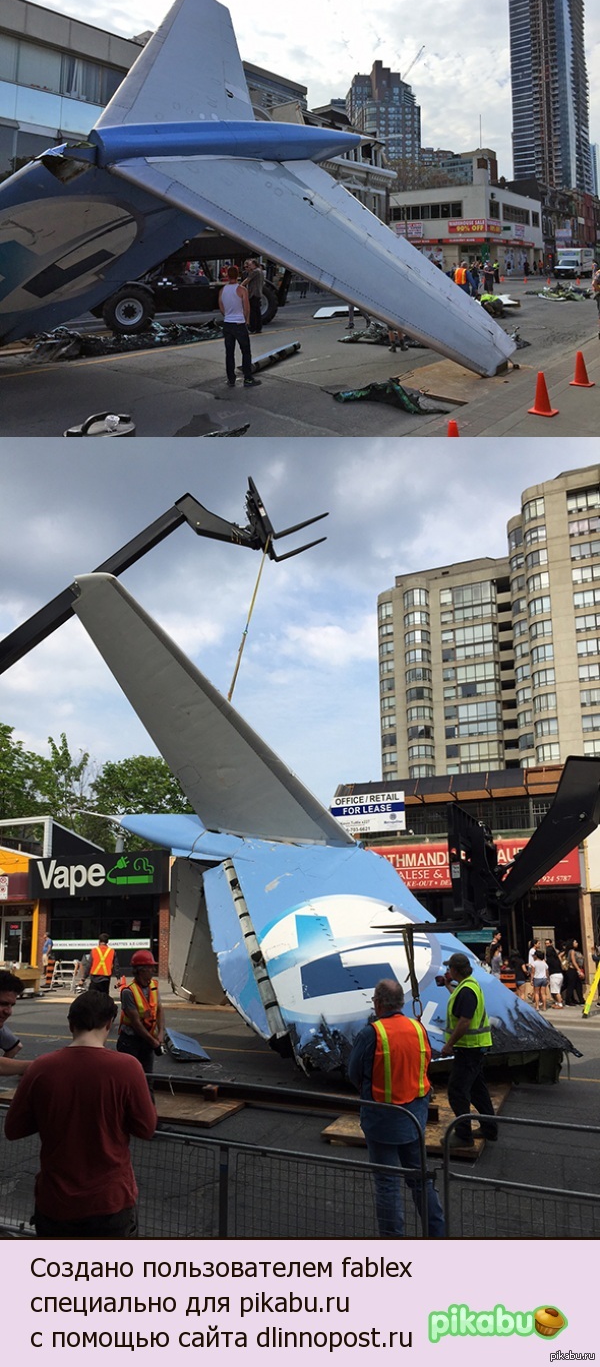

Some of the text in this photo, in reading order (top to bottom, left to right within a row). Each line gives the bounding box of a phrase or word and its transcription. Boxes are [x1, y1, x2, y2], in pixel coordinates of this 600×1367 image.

[335, 795, 364, 805] OFFICE
[369, 793, 399, 802] RETAIL
[343, 804, 392, 815] FOR LEASE
[384, 851, 449, 867] THMAND
[36, 859, 106, 896] Vape
[433, 869, 443, 879] &
[556, 874, 572, 882] 5787
